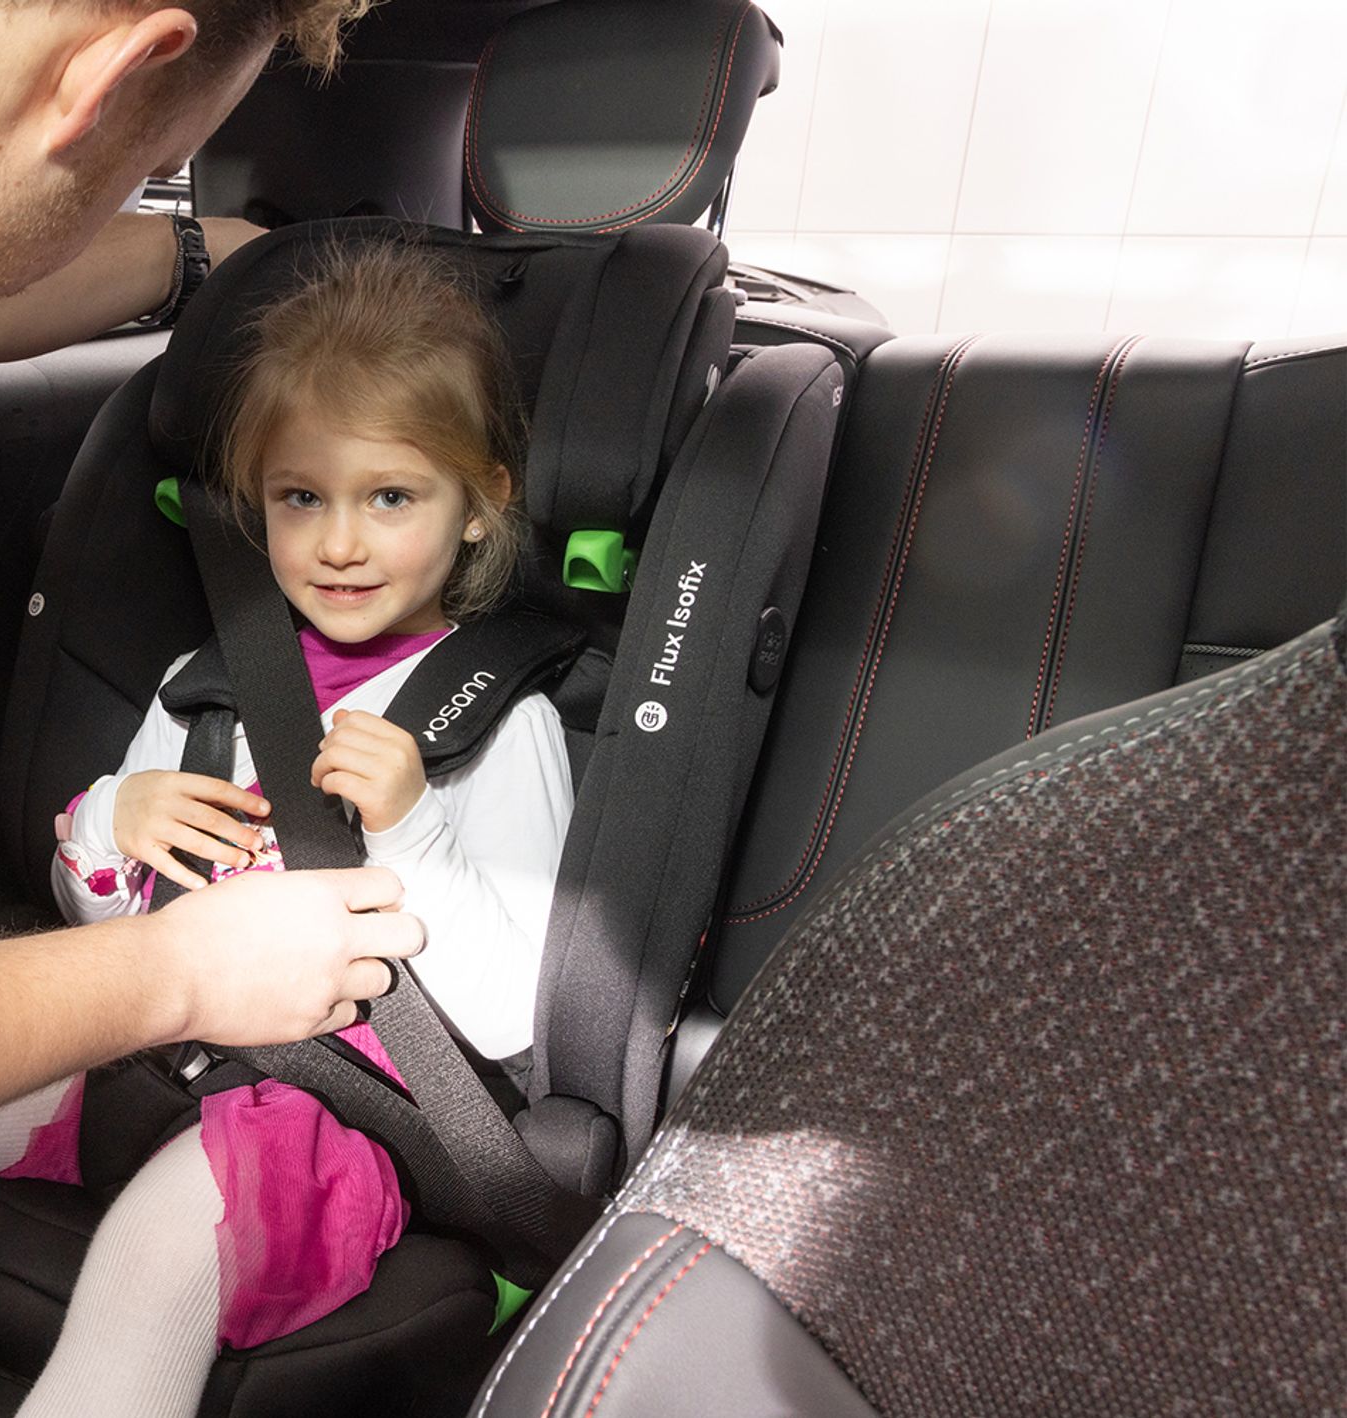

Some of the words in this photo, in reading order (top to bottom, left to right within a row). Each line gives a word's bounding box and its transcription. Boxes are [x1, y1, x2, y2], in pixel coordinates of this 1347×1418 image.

[666, 560, 707, 628] Isofix
[649, 632, 684, 686] Flux
[426, 670, 496, 733] osann
